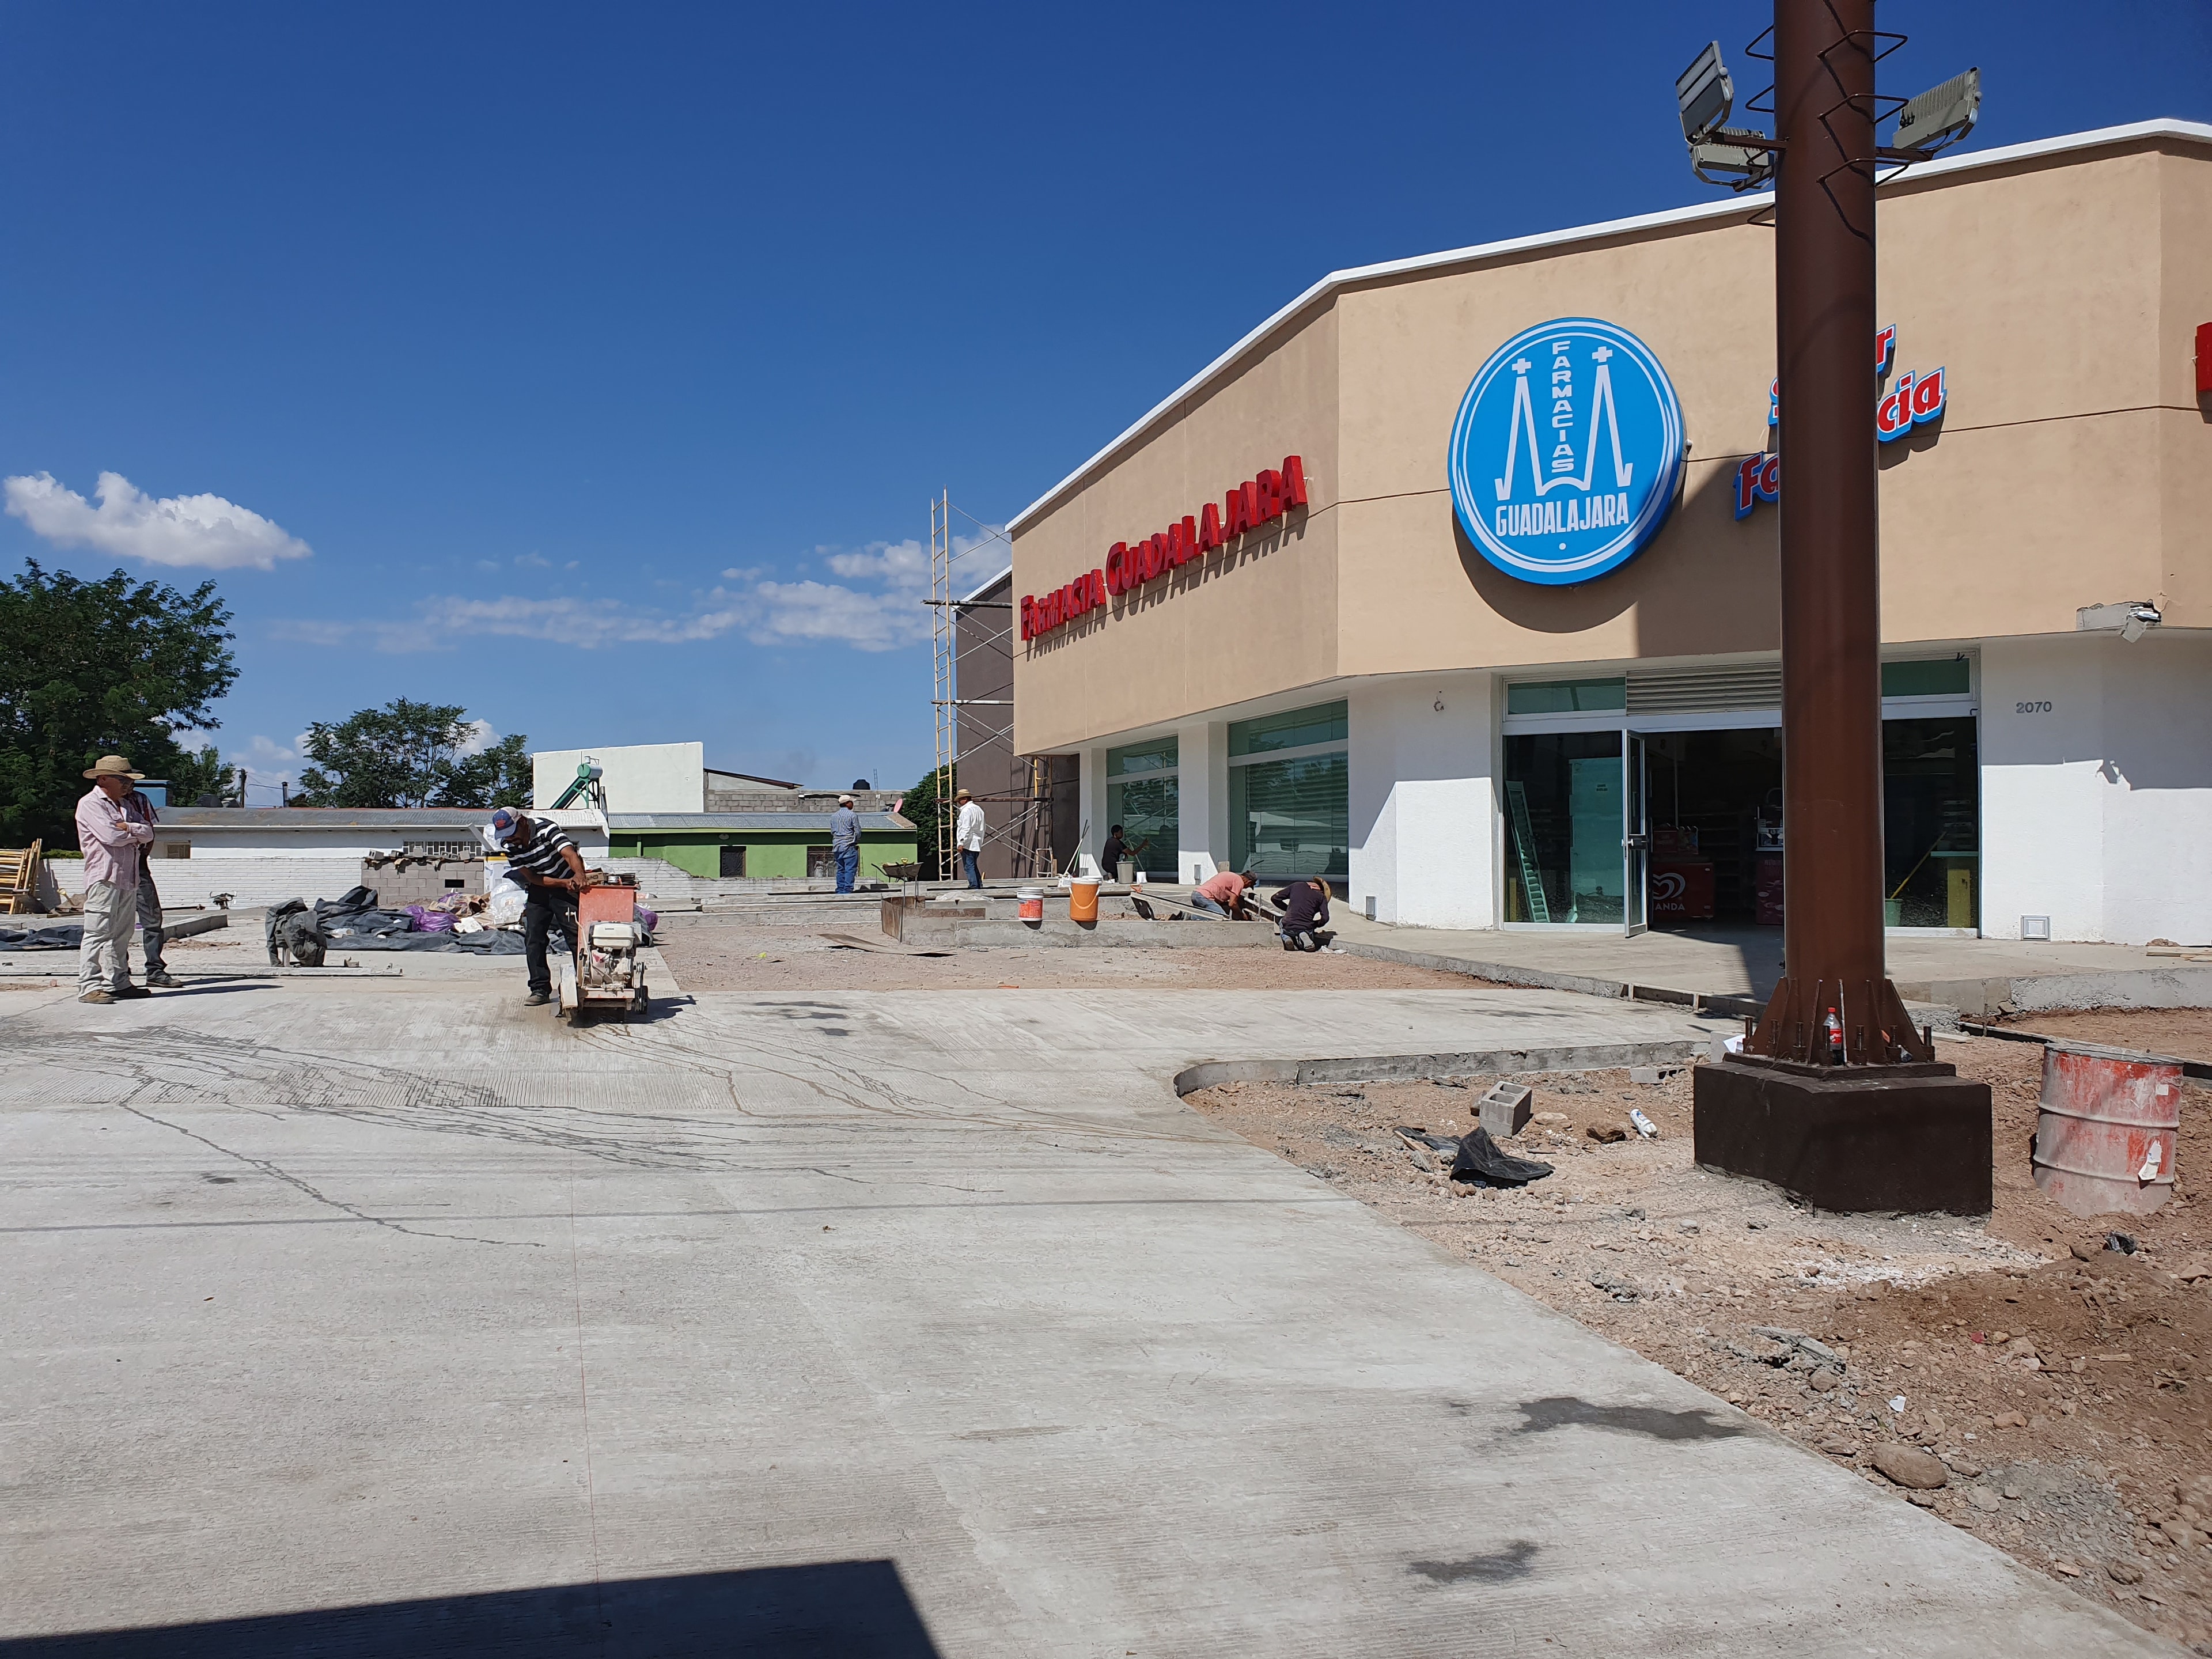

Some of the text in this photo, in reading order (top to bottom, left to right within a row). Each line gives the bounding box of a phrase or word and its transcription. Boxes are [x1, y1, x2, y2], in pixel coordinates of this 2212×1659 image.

[1551, 340, 1574, 473] FARMACIAS
[1495, 493, 1629, 536] GUADALAJARA
[1021, 455, 1308, 641] FARMACIA GUADALAJARA
[2016, 701, 2052, 713] 2070
[1655, 903, 1685, 911] ANDA
